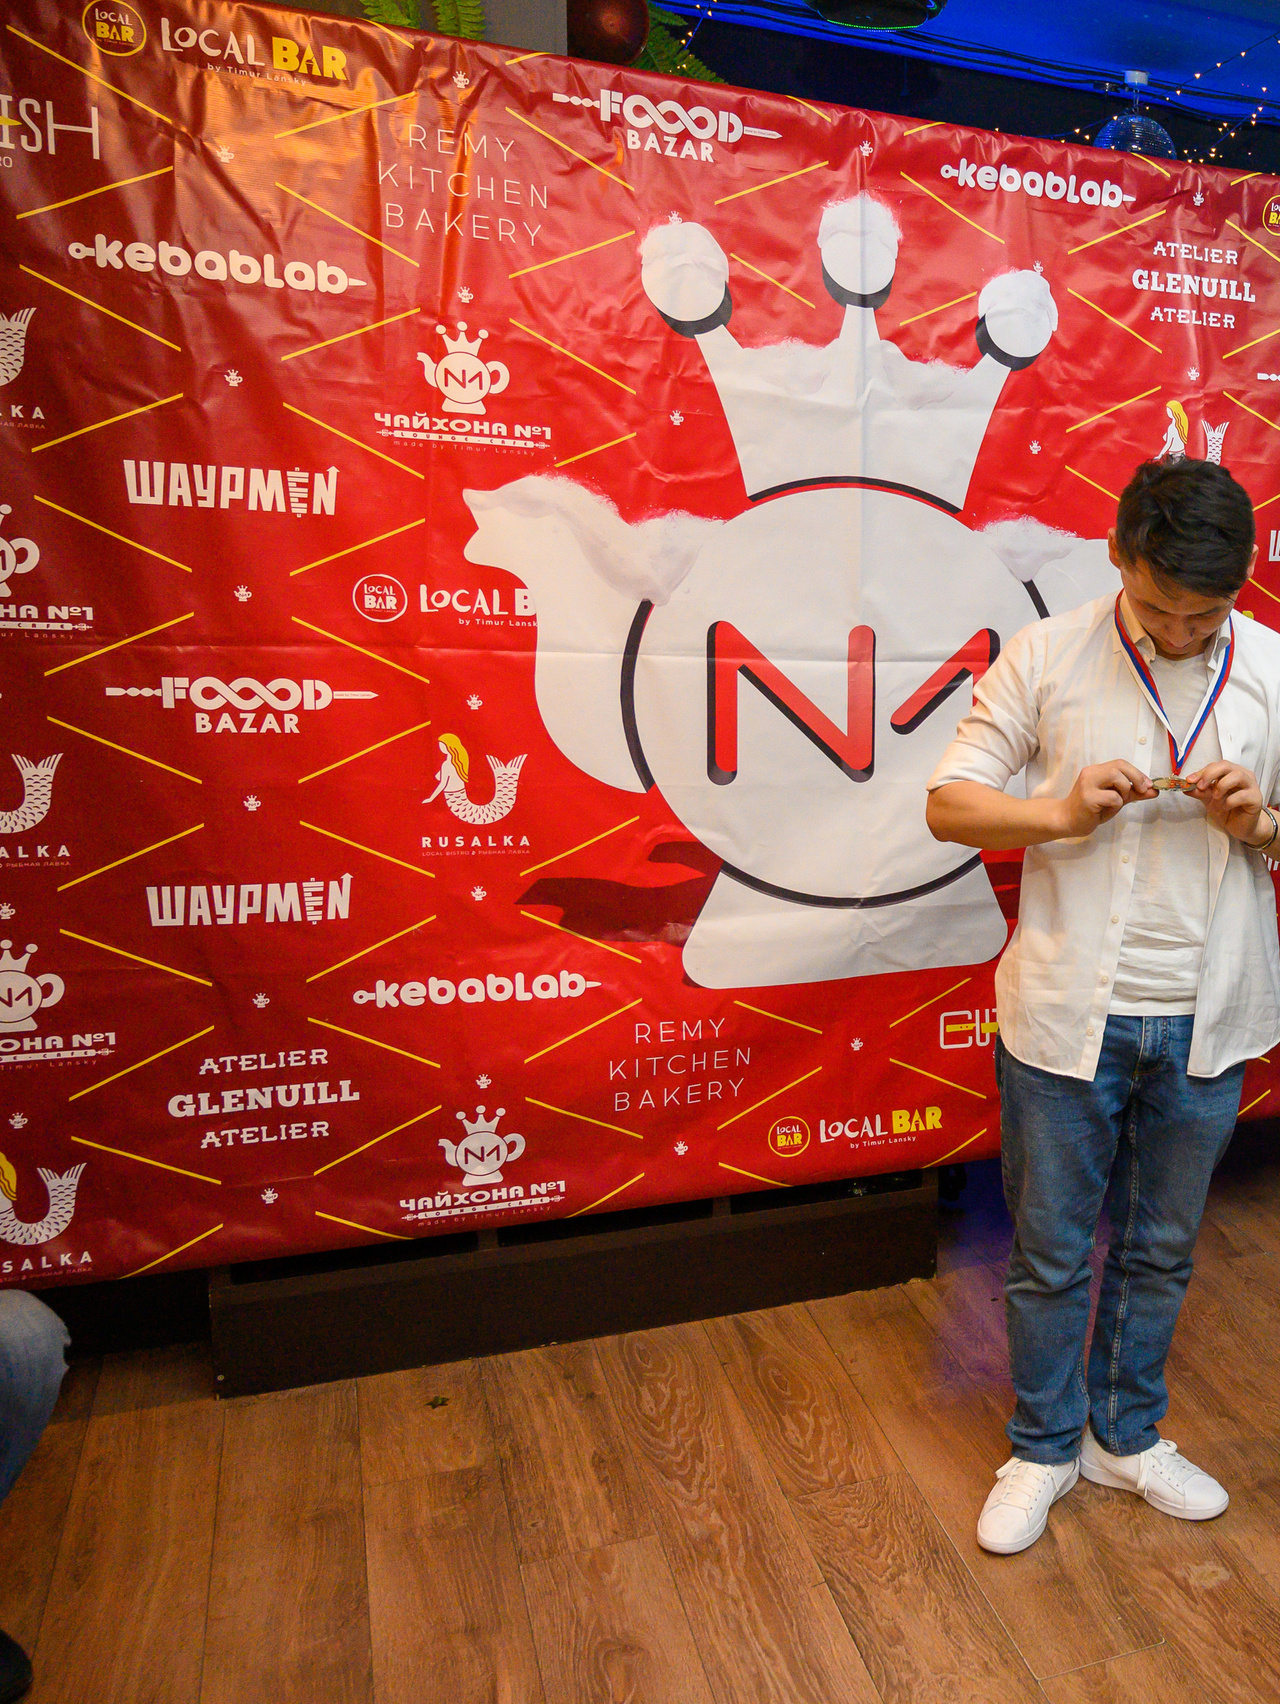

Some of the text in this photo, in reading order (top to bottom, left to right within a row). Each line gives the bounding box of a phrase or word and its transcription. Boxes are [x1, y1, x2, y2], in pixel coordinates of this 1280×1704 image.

[96, 21, 134, 43] BAR
[161, 17, 348, 81] LOCAL BAR
[207, 63, 221, 73] by
[227, 66, 260, 78] Timur
[409, 124, 514, 162] REMY
[627, 129, 714, 163] BAZAR
[378, 160, 547, 209] KITCHEN
[386, 202, 541, 247] BAKERY
[1153, 241, 1238, 265] ATELIER
[1132, 268, 1256, 303] GLENUILL
[1150, 306, 1235, 329] ATELIER
[0, 404, 45, 419] KA
[373, 411, 507, 437] ЧАЙХОНА
[453, 444, 487, 452] Timur
[364, 594, 398, 610] BAR
[420, 584, 508, 616] LOCAL
[458, 618, 470, 626] by
[475, 618, 504, 627] Timur
[195, 712, 301, 734] BAZAR
[421, 835, 531, 848] RUSALKA
[635, 1017, 726, 1044] REMY
[199, 1048, 329, 1076] ATELIER
[609, 1046, 751, 1081] KITCHEN
[168, 1080, 360, 1118] GLENUILL
[615, 1077, 745, 1112] BAKERY
[200, 1120, 330, 1149] ATELIER
[819, 1105, 943, 1144] LOCAL BAR
[777, 1132, 803, 1147] BAR
[863, 1139, 886, 1147] Timur
[888, 1136, 917, 1144] Lansky
[400, 1186, 524, 1212] ЧАЙХОНА
